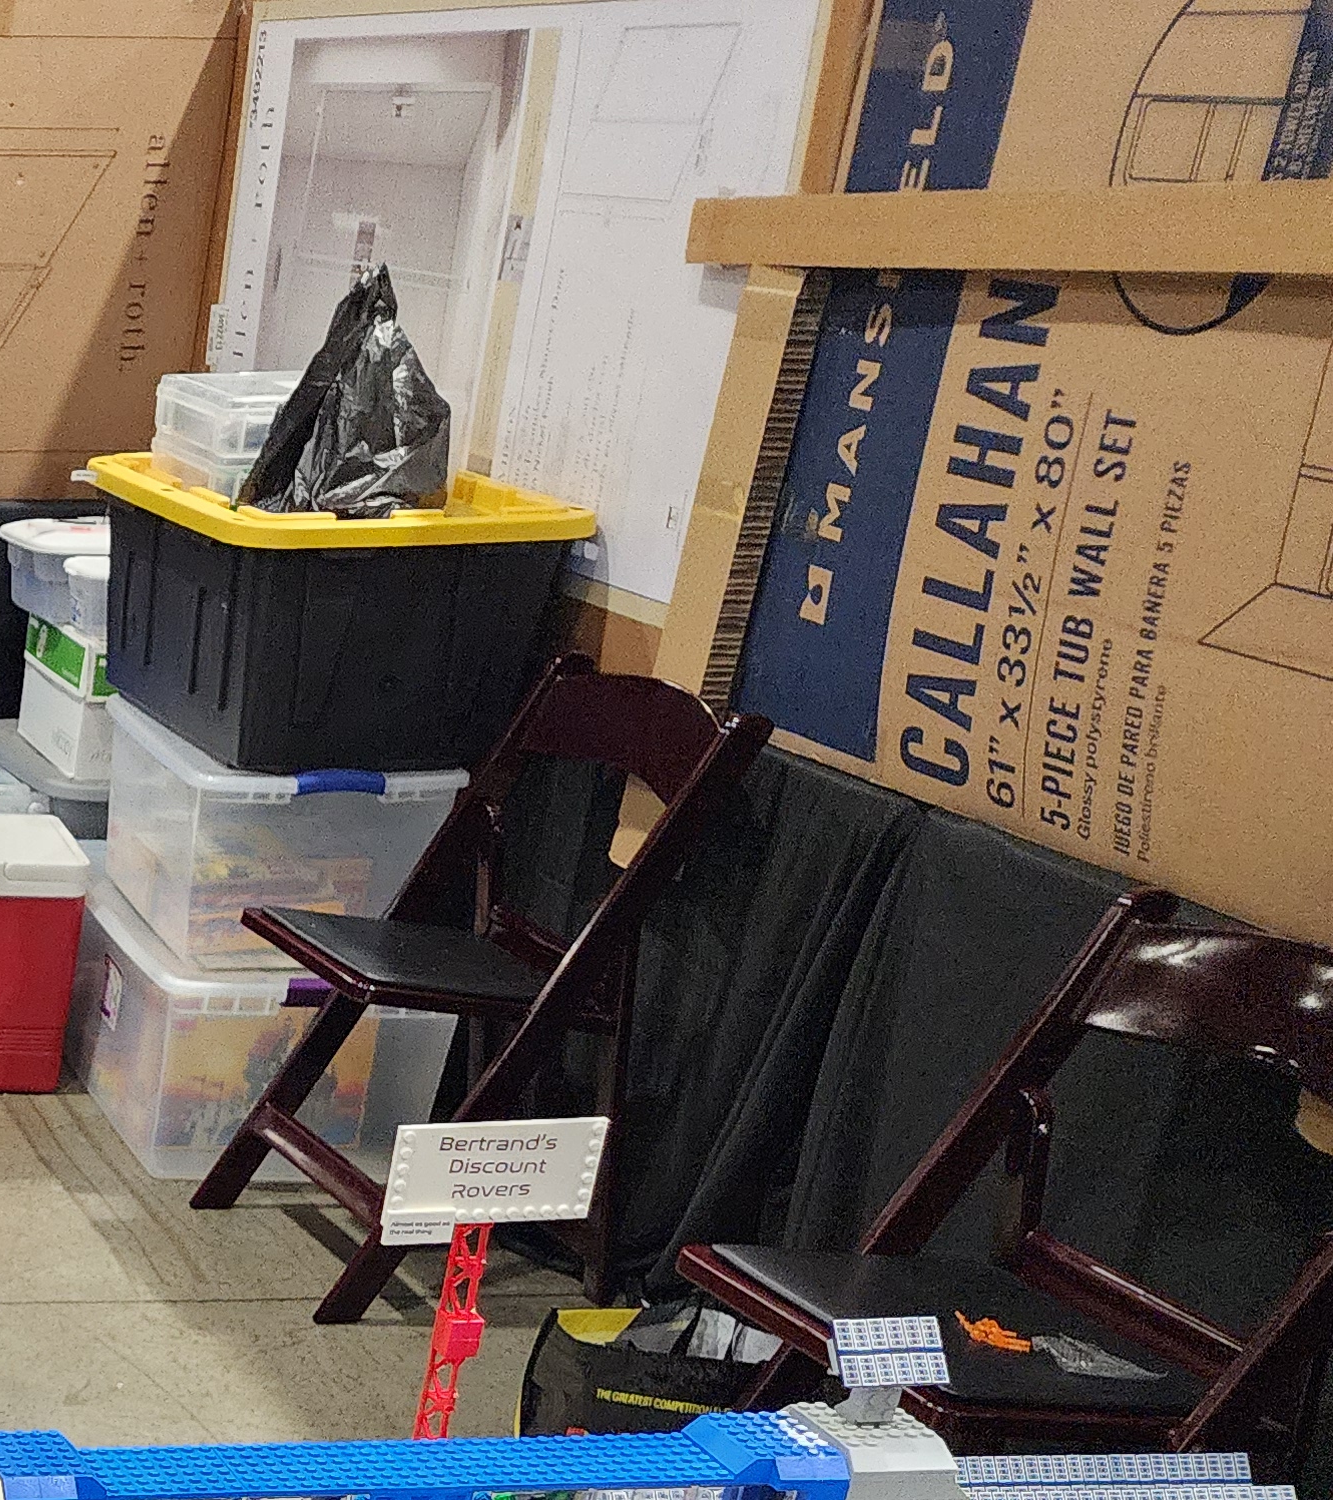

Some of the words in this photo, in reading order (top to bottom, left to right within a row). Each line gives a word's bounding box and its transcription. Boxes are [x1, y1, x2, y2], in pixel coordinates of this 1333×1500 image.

[135, 134, 171, 237] allen
[1093, 408, 1137, 482] SET
[1160, 460, 1192, 534] PIEZAS
[899, 278, 1061, 787] CALLAHAN
[1067, 499, 1120, 598] WALL
[1156, 540, 1174, 553] 5
[1053, 614, 1094, 683] TUB
[1130, 649, 1154, 700] PARA
[1086, 638, 1113, 771] polystyrene
[1120, 705, 1145, 767] PARED
[1039, 696, 1081, 831] 5-PIECE
[1117, 769, 1135, 798] DE
[1076, 771, 1098, 841] Glossy
[1112, 800, 1132, 857] JUEGO
[438, 1133, 558, 1152] Bertrand's
[448, 1158, 547, 1175] Discount
[451, 1183, 531, 1200] Rovers
[596, 1387, 611, 1402] THE
[612, 1391, 653, 1408] GREATEST
